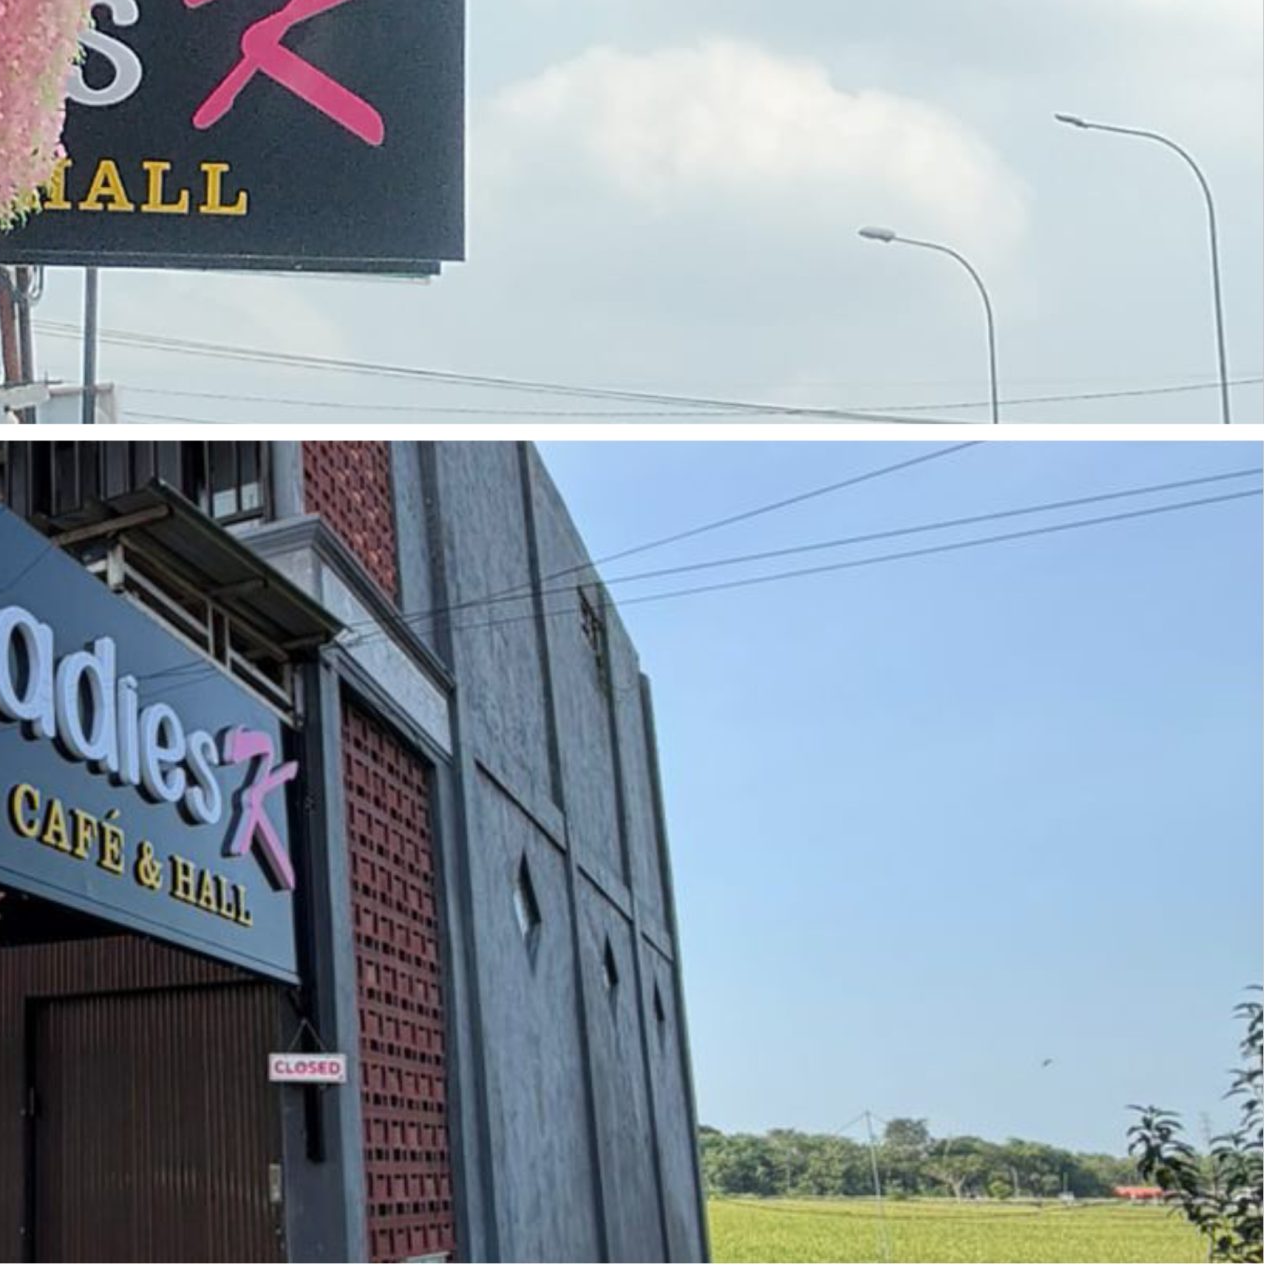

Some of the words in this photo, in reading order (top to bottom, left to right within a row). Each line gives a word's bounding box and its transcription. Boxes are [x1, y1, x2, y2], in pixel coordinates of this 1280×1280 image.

[11, 782, 125, 875] CAFÉ
[137, 839, 162, 891] &
[171, 853, 254, 928] HALL
[224, 724, 298, 891] K
[274, 1060, 341, 1075] CLOSED
